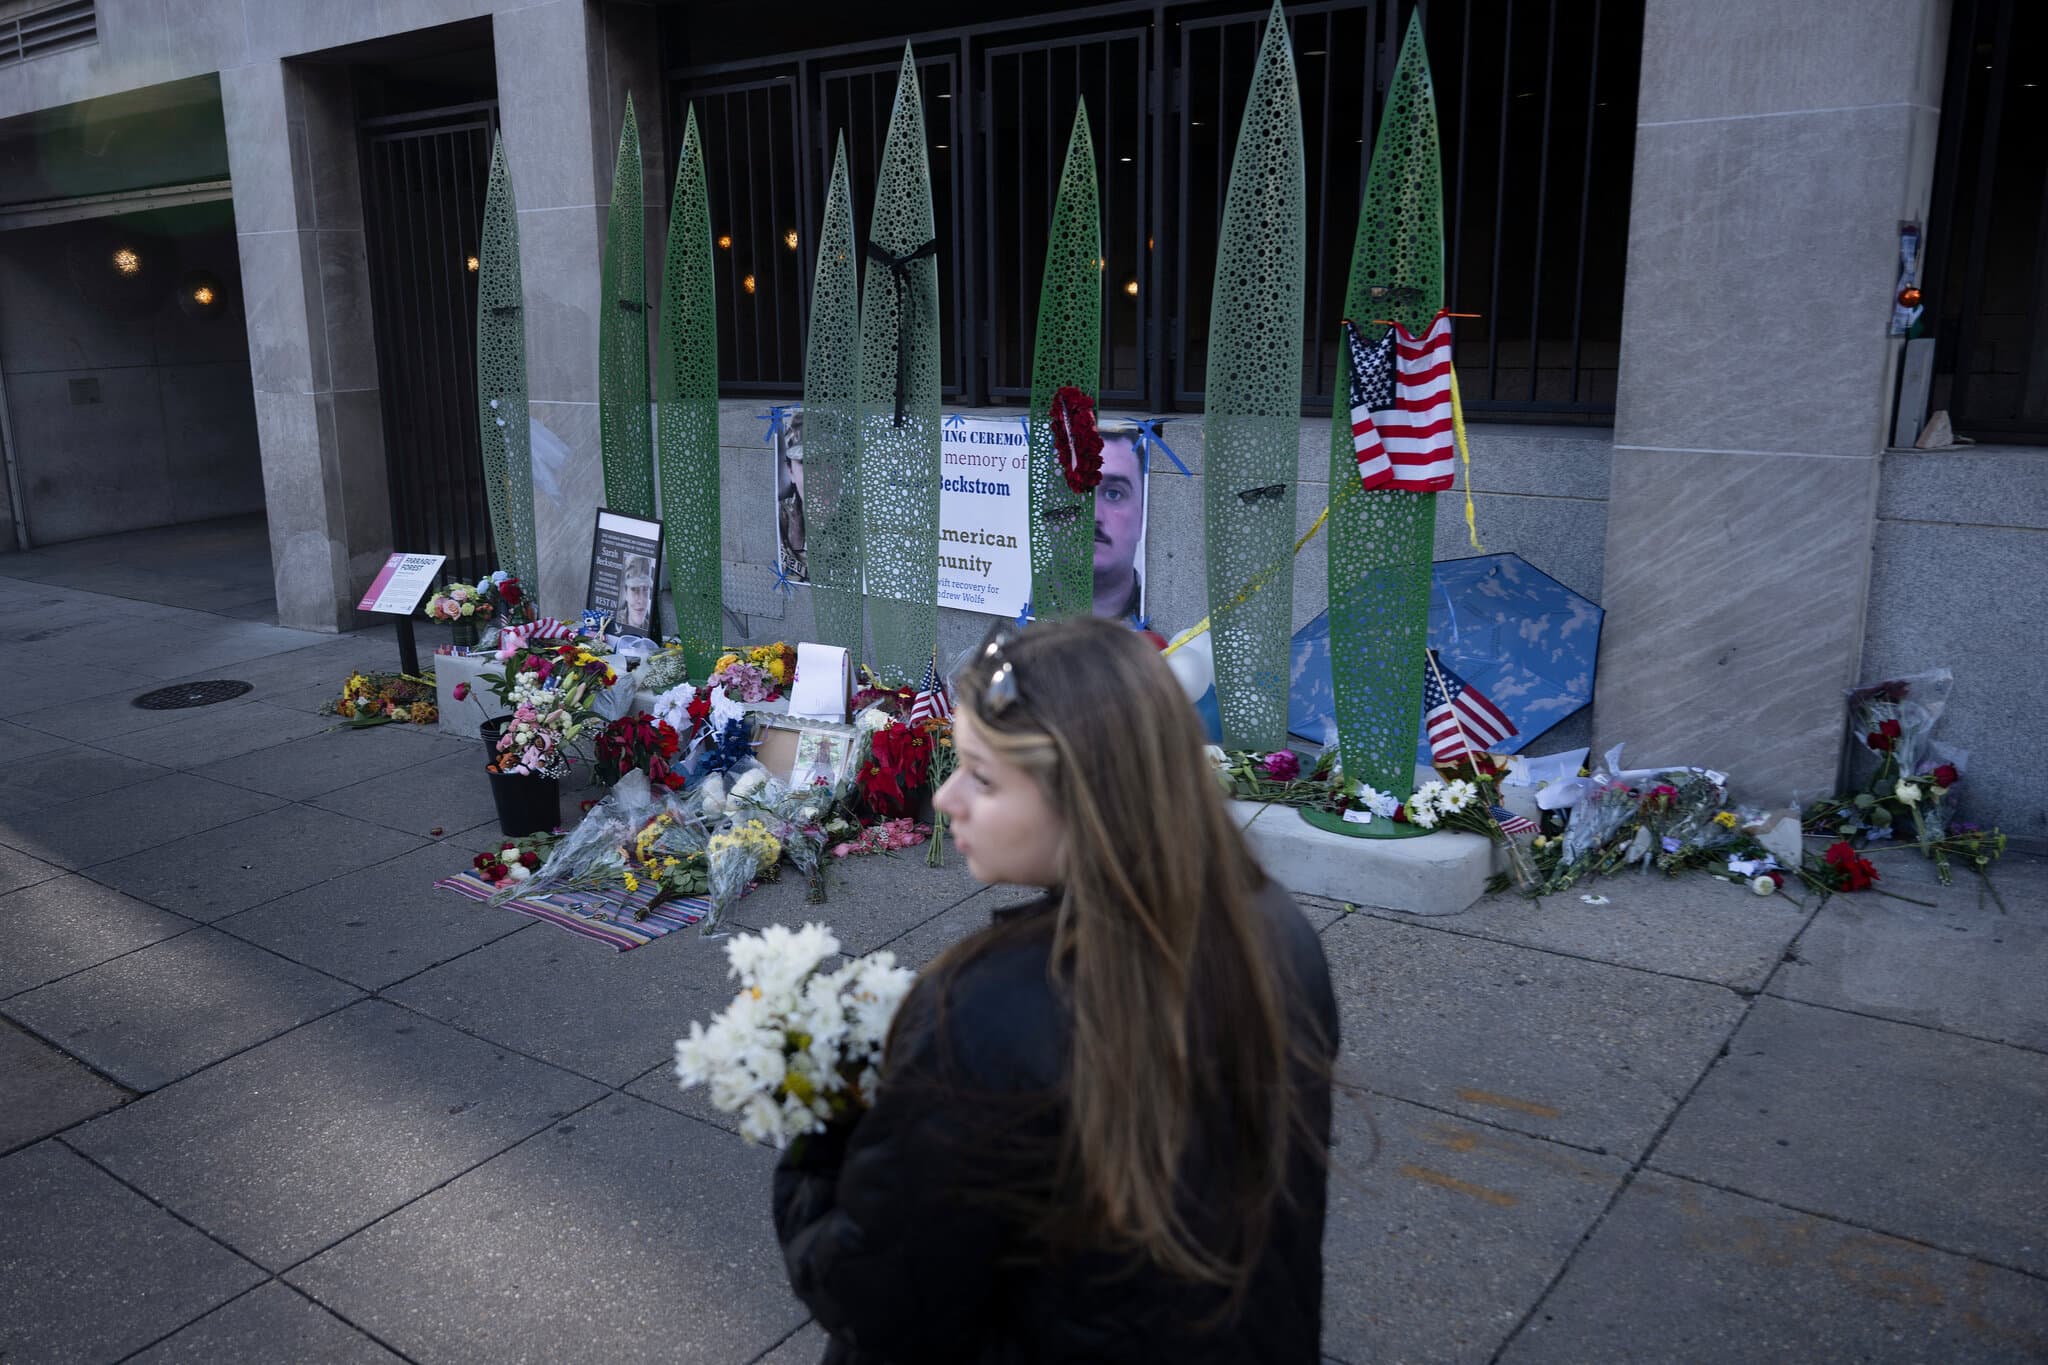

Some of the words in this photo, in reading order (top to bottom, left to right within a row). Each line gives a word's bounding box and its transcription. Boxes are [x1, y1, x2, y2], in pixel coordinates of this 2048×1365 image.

[944, 452, 1007, 472] memory
[1011, 454, 1028, 470] of
[939, 528, 1018, 548] merican
[952, 581, 986, 594] recovery
[987, 583, 1000, 594] for
[595, 596, 610, 607] REST
[962, 592, 985, 604] Wolfe
